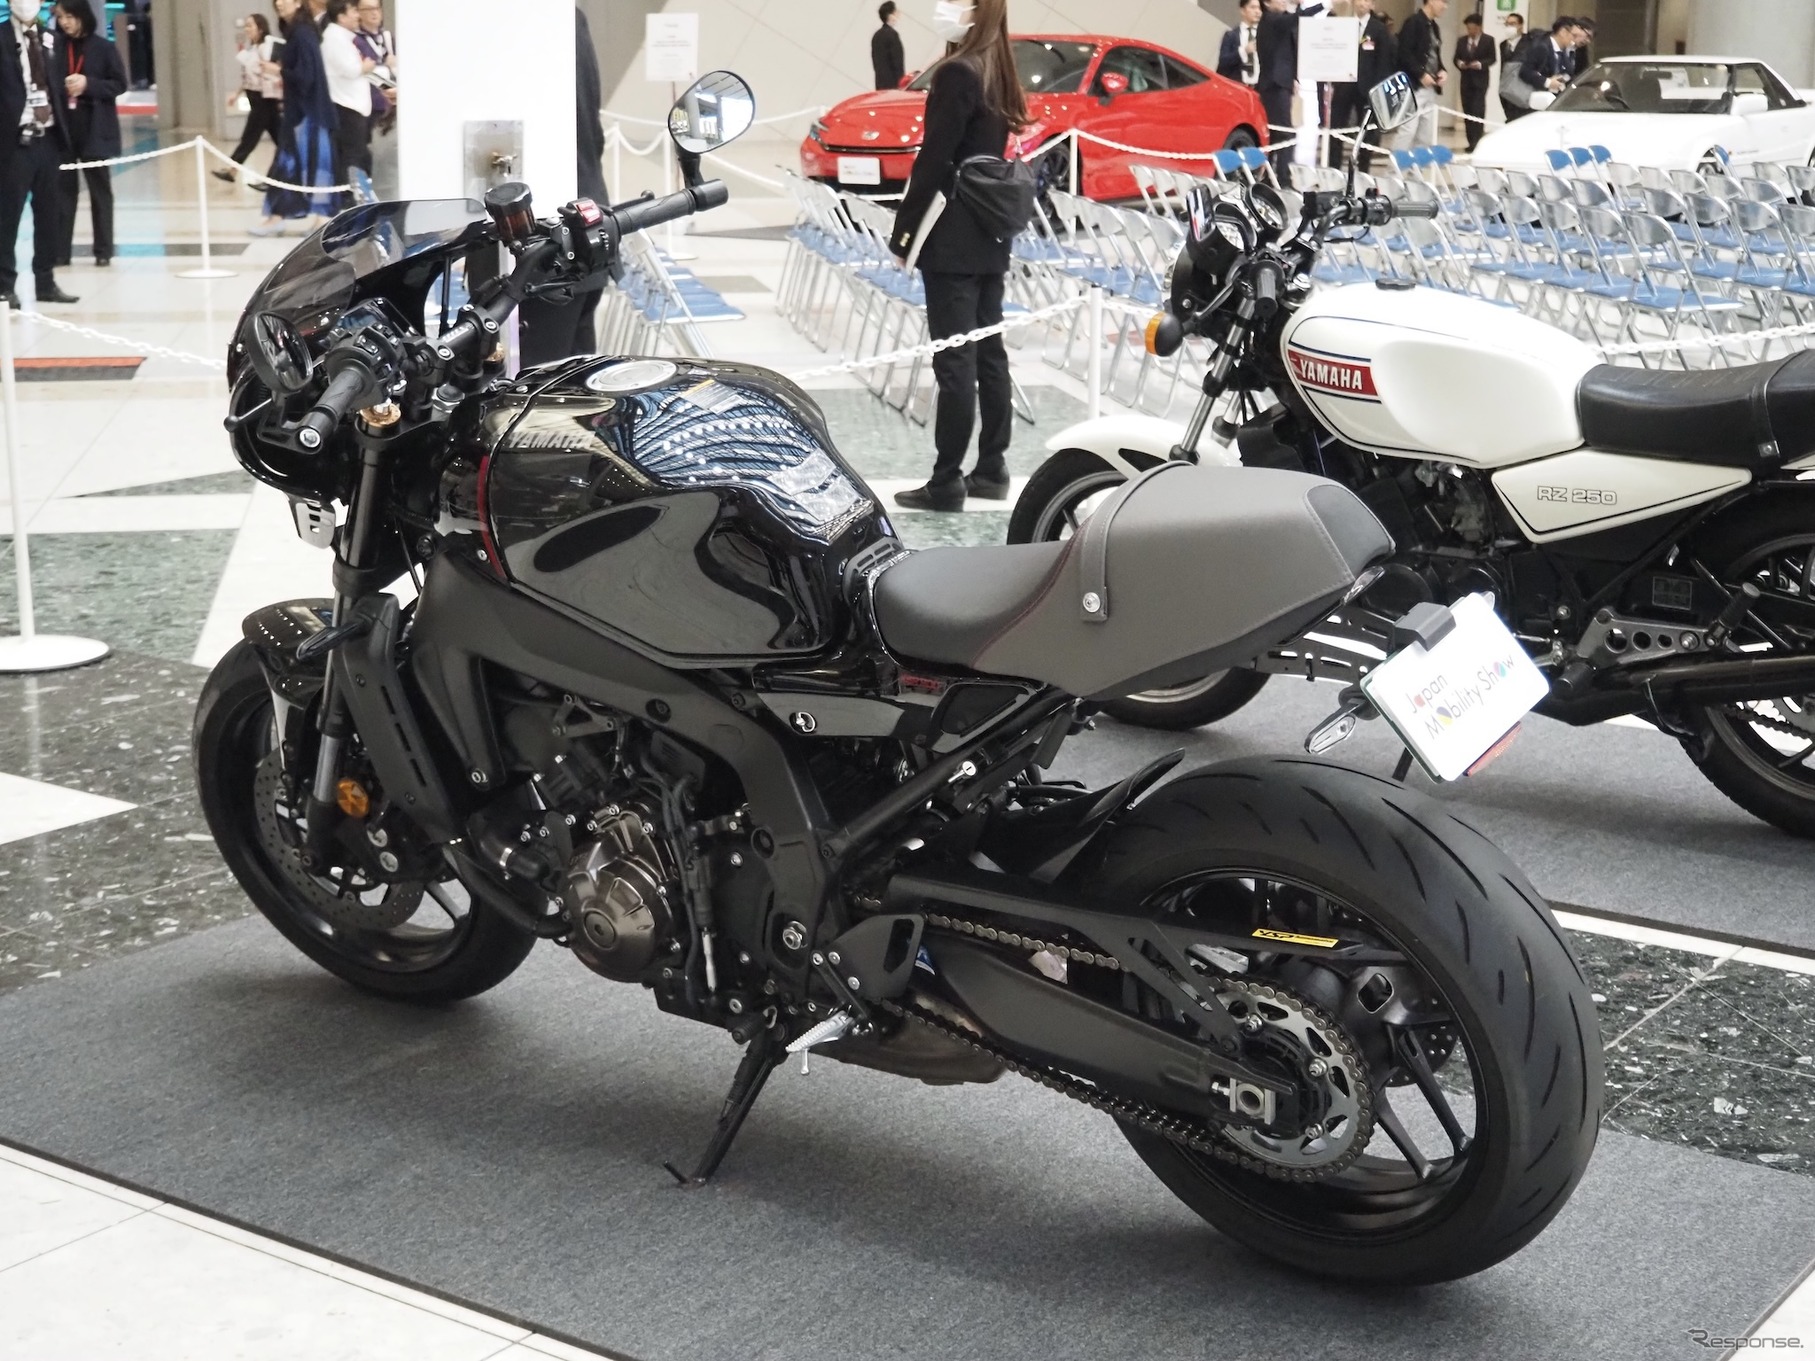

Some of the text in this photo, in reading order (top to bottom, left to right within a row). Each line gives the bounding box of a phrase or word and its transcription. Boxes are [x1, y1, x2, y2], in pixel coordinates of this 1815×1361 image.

[1300, 359, 1363, 390] YAMAHA
[509, 430, 595, 449] YAMAHA
[1537, 486, 1617, 505] RZ 250
[1405, 674, 1448, 714] Japan
[1424, 654, 1514, 740] Mobility Show
